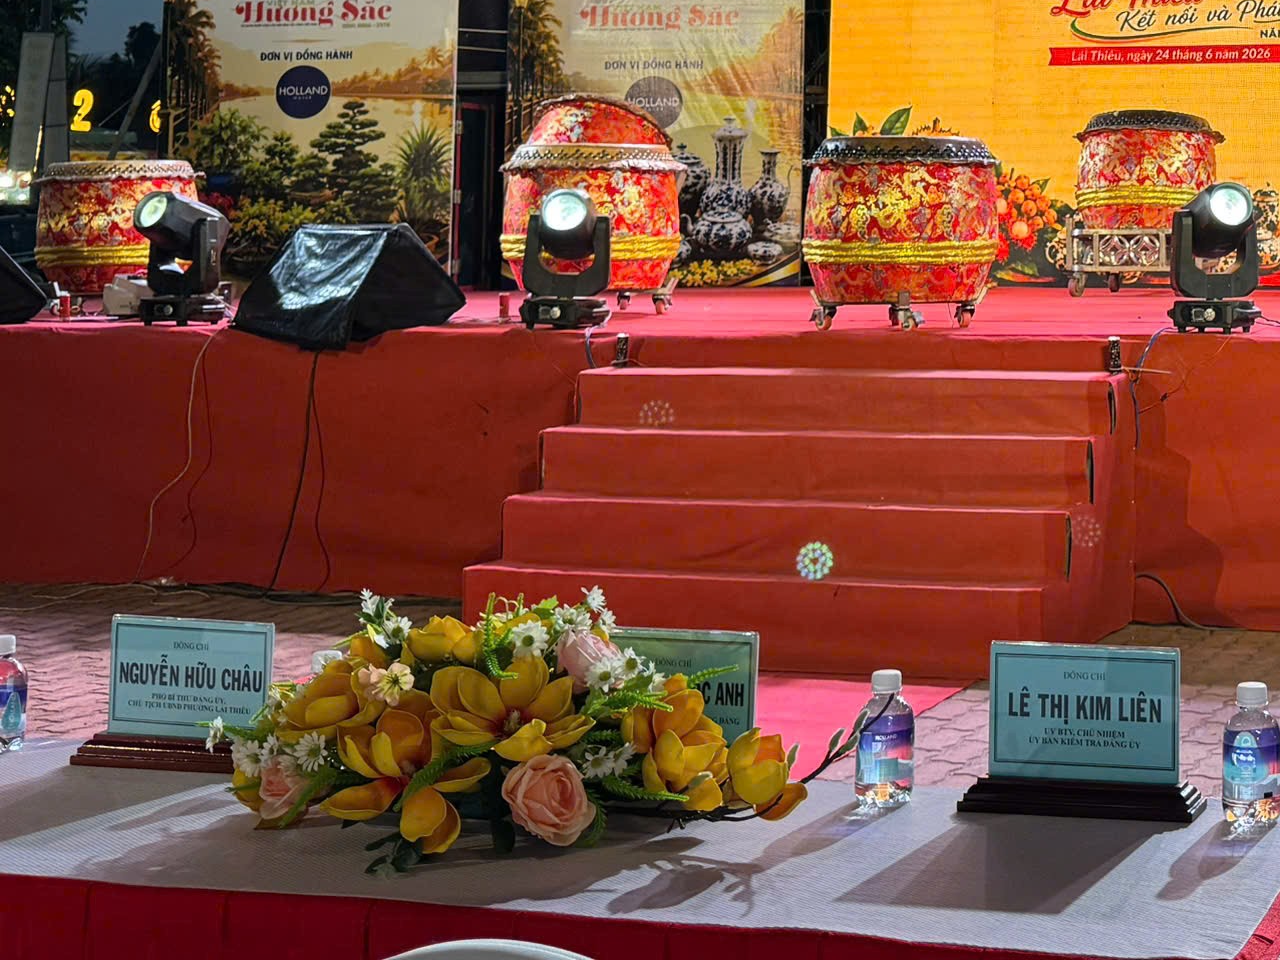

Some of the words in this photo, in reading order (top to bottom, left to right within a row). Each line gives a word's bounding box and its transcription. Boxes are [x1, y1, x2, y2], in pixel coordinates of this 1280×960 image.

[1117, 11, 1155, 32] Kết
[1165, 8, 1198, 25] nối
[1207, 8, 1231, 22] và
[1126, 51, 1153, 63] ngày
[1155, 51, 1169, 60] 24
[1206, 51, 1212, 60] 6
[1242, 49, 1270, 59] 2026
[280, 86, 328, 96] HOLLAND
[120, 654, 179, 687] NGUYỄN
[185, 661, 216, 689] HỮU
[221, 664, 262, 692] CHÂU
[715, 682, 744, 706] ANH
[1009, 686, 1030, 717] LÊ
[1038, 694, 1068, 724] THỊ
[1077, 696, 1111, 720] KIM
[1119, 691, 1161, 723] LIÊN
